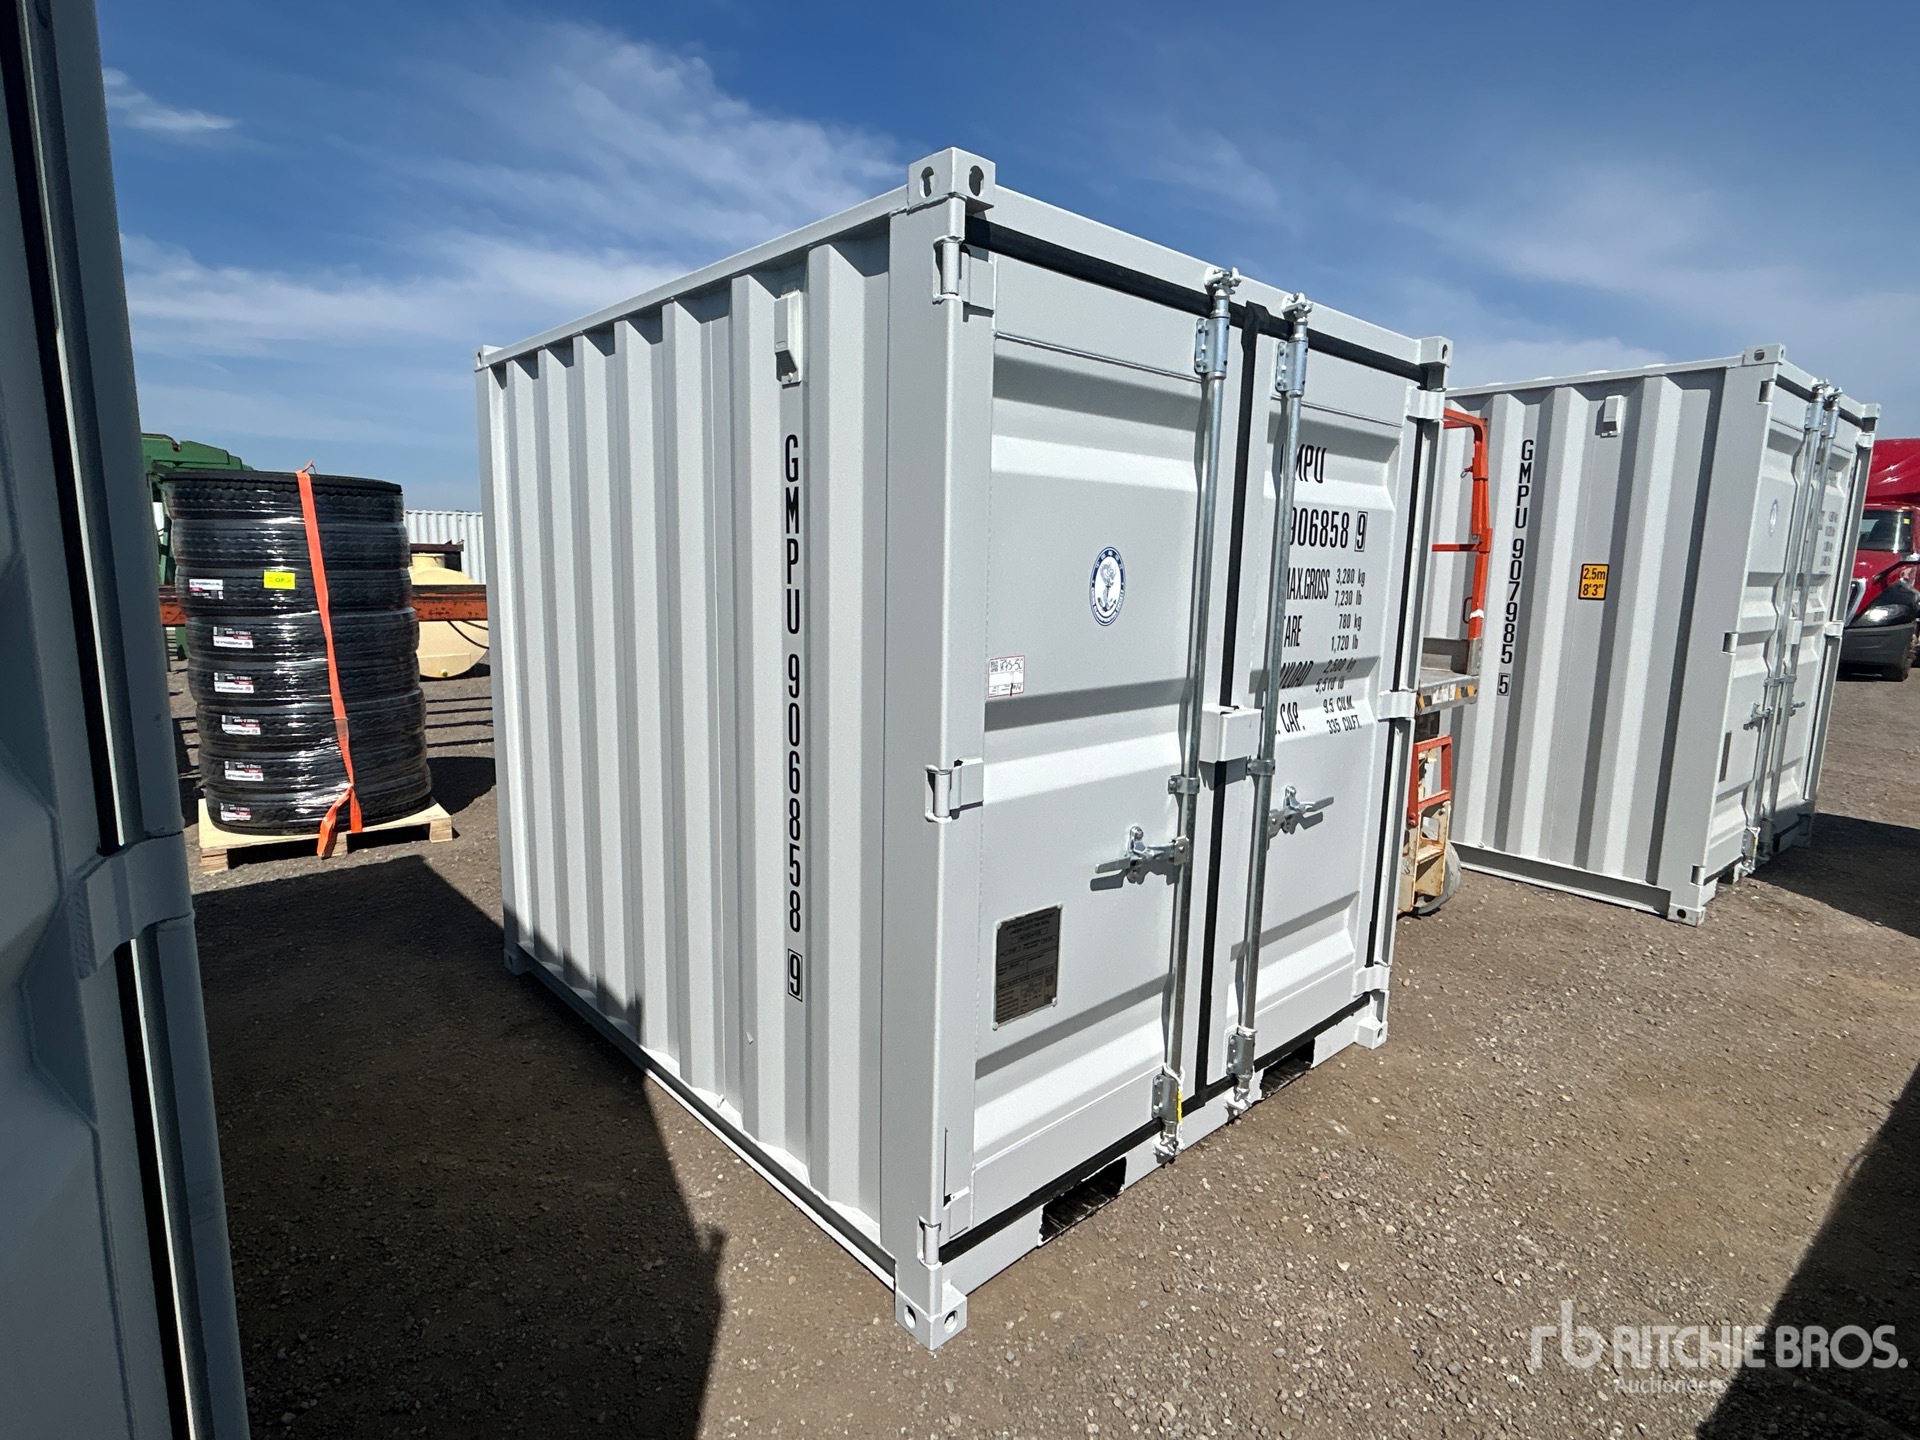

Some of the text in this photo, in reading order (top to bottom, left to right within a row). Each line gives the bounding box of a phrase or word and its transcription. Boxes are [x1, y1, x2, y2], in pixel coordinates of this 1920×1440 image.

[1356, 512, 1367, 551] 9
[1498, 439, 1534, 695] GMPU 907985 5
[1583, 567, 1606, 580] 2.5m
[1335, 568, 1366, 587] 3,280 kg
[1334, 589, 1362, 608] 7,230 lb
[1283, 615, 1302, 647] ARE
[1338, 613, 1362, 631] 780 kg
[1331, 634, 1358, 653] 1,720 lb
[785, 434, 802, 999] GMPU 906858 9
[1279, 701, 1305, 733] CAP.
[1326, 718, 1341, 734] 335
